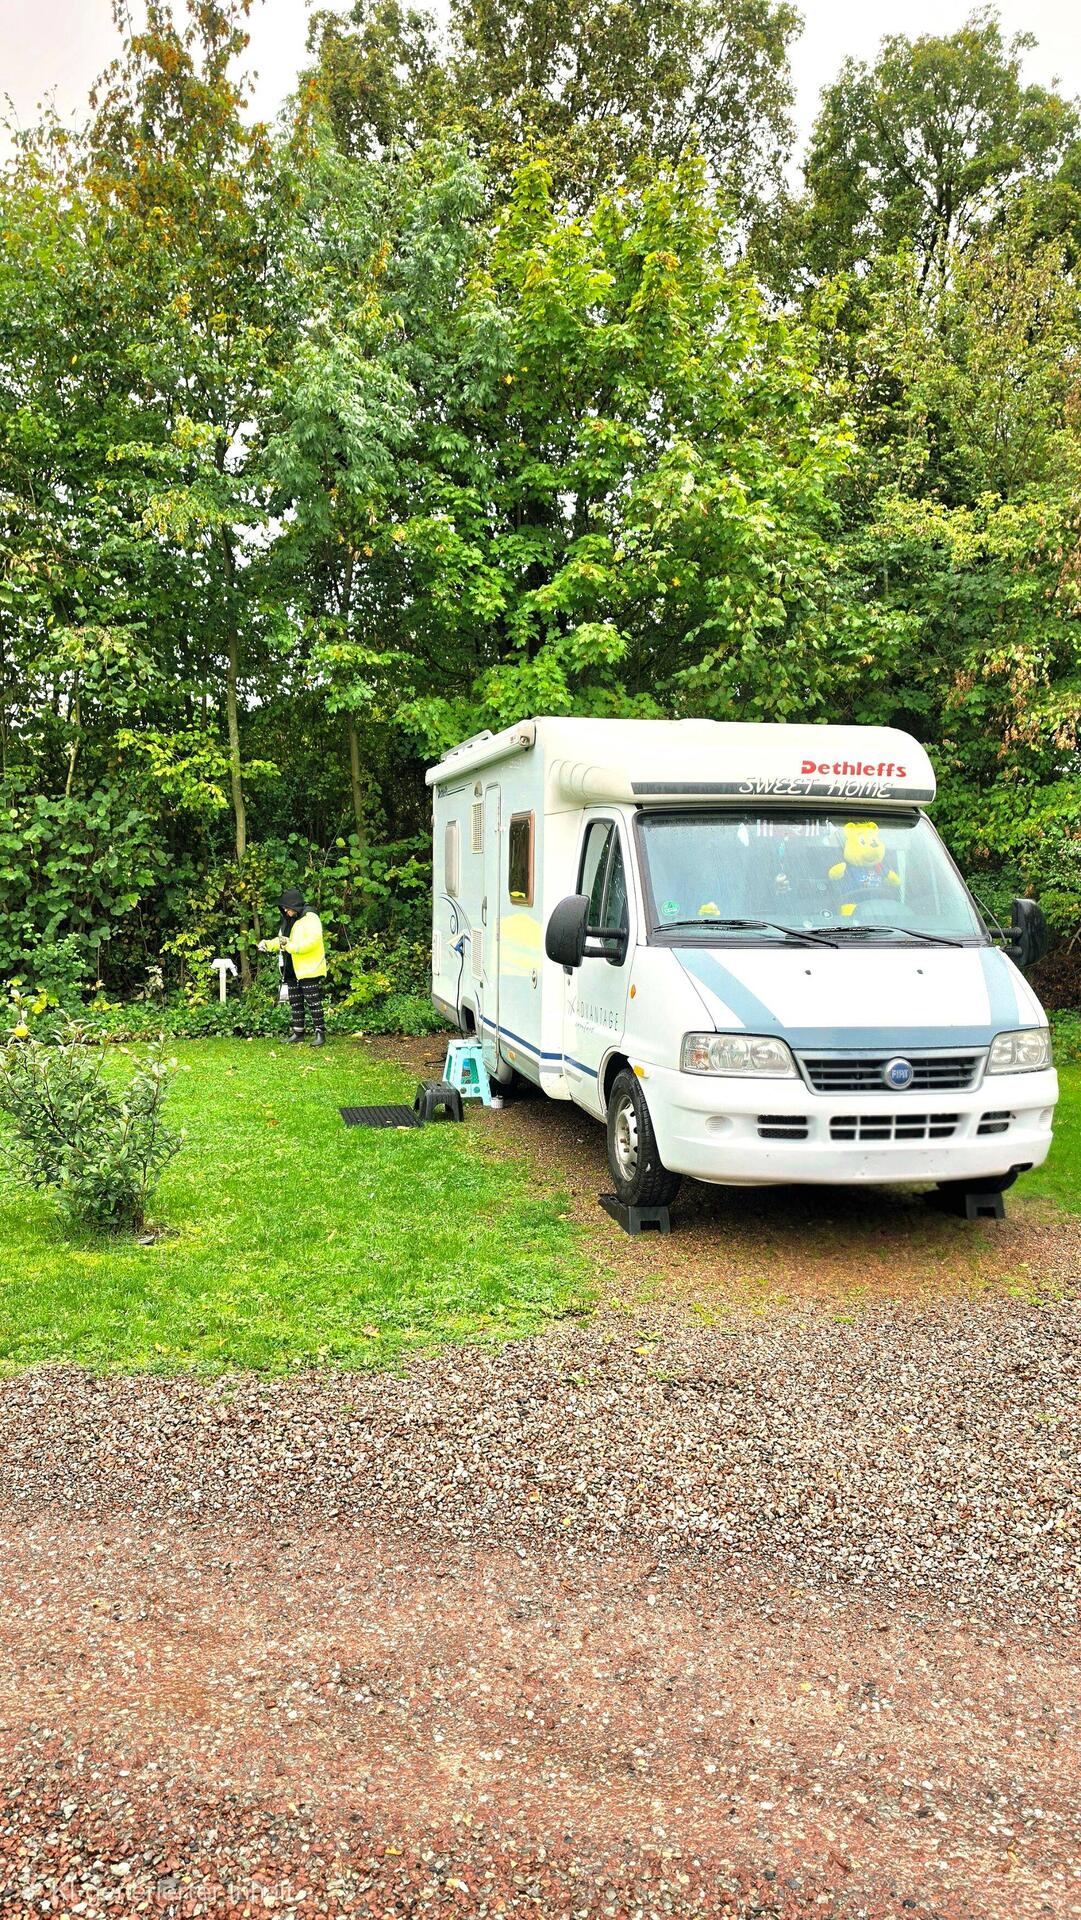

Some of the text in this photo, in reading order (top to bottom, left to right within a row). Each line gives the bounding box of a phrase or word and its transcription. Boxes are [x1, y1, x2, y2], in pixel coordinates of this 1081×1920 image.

[801, 760, 907, 778] Dethleffs
[739, 777, 820, 796] SWEET
[576, 1000, 619, 1031] ADVANTAGE
[892, 1069, 909, 1079] FIAT
